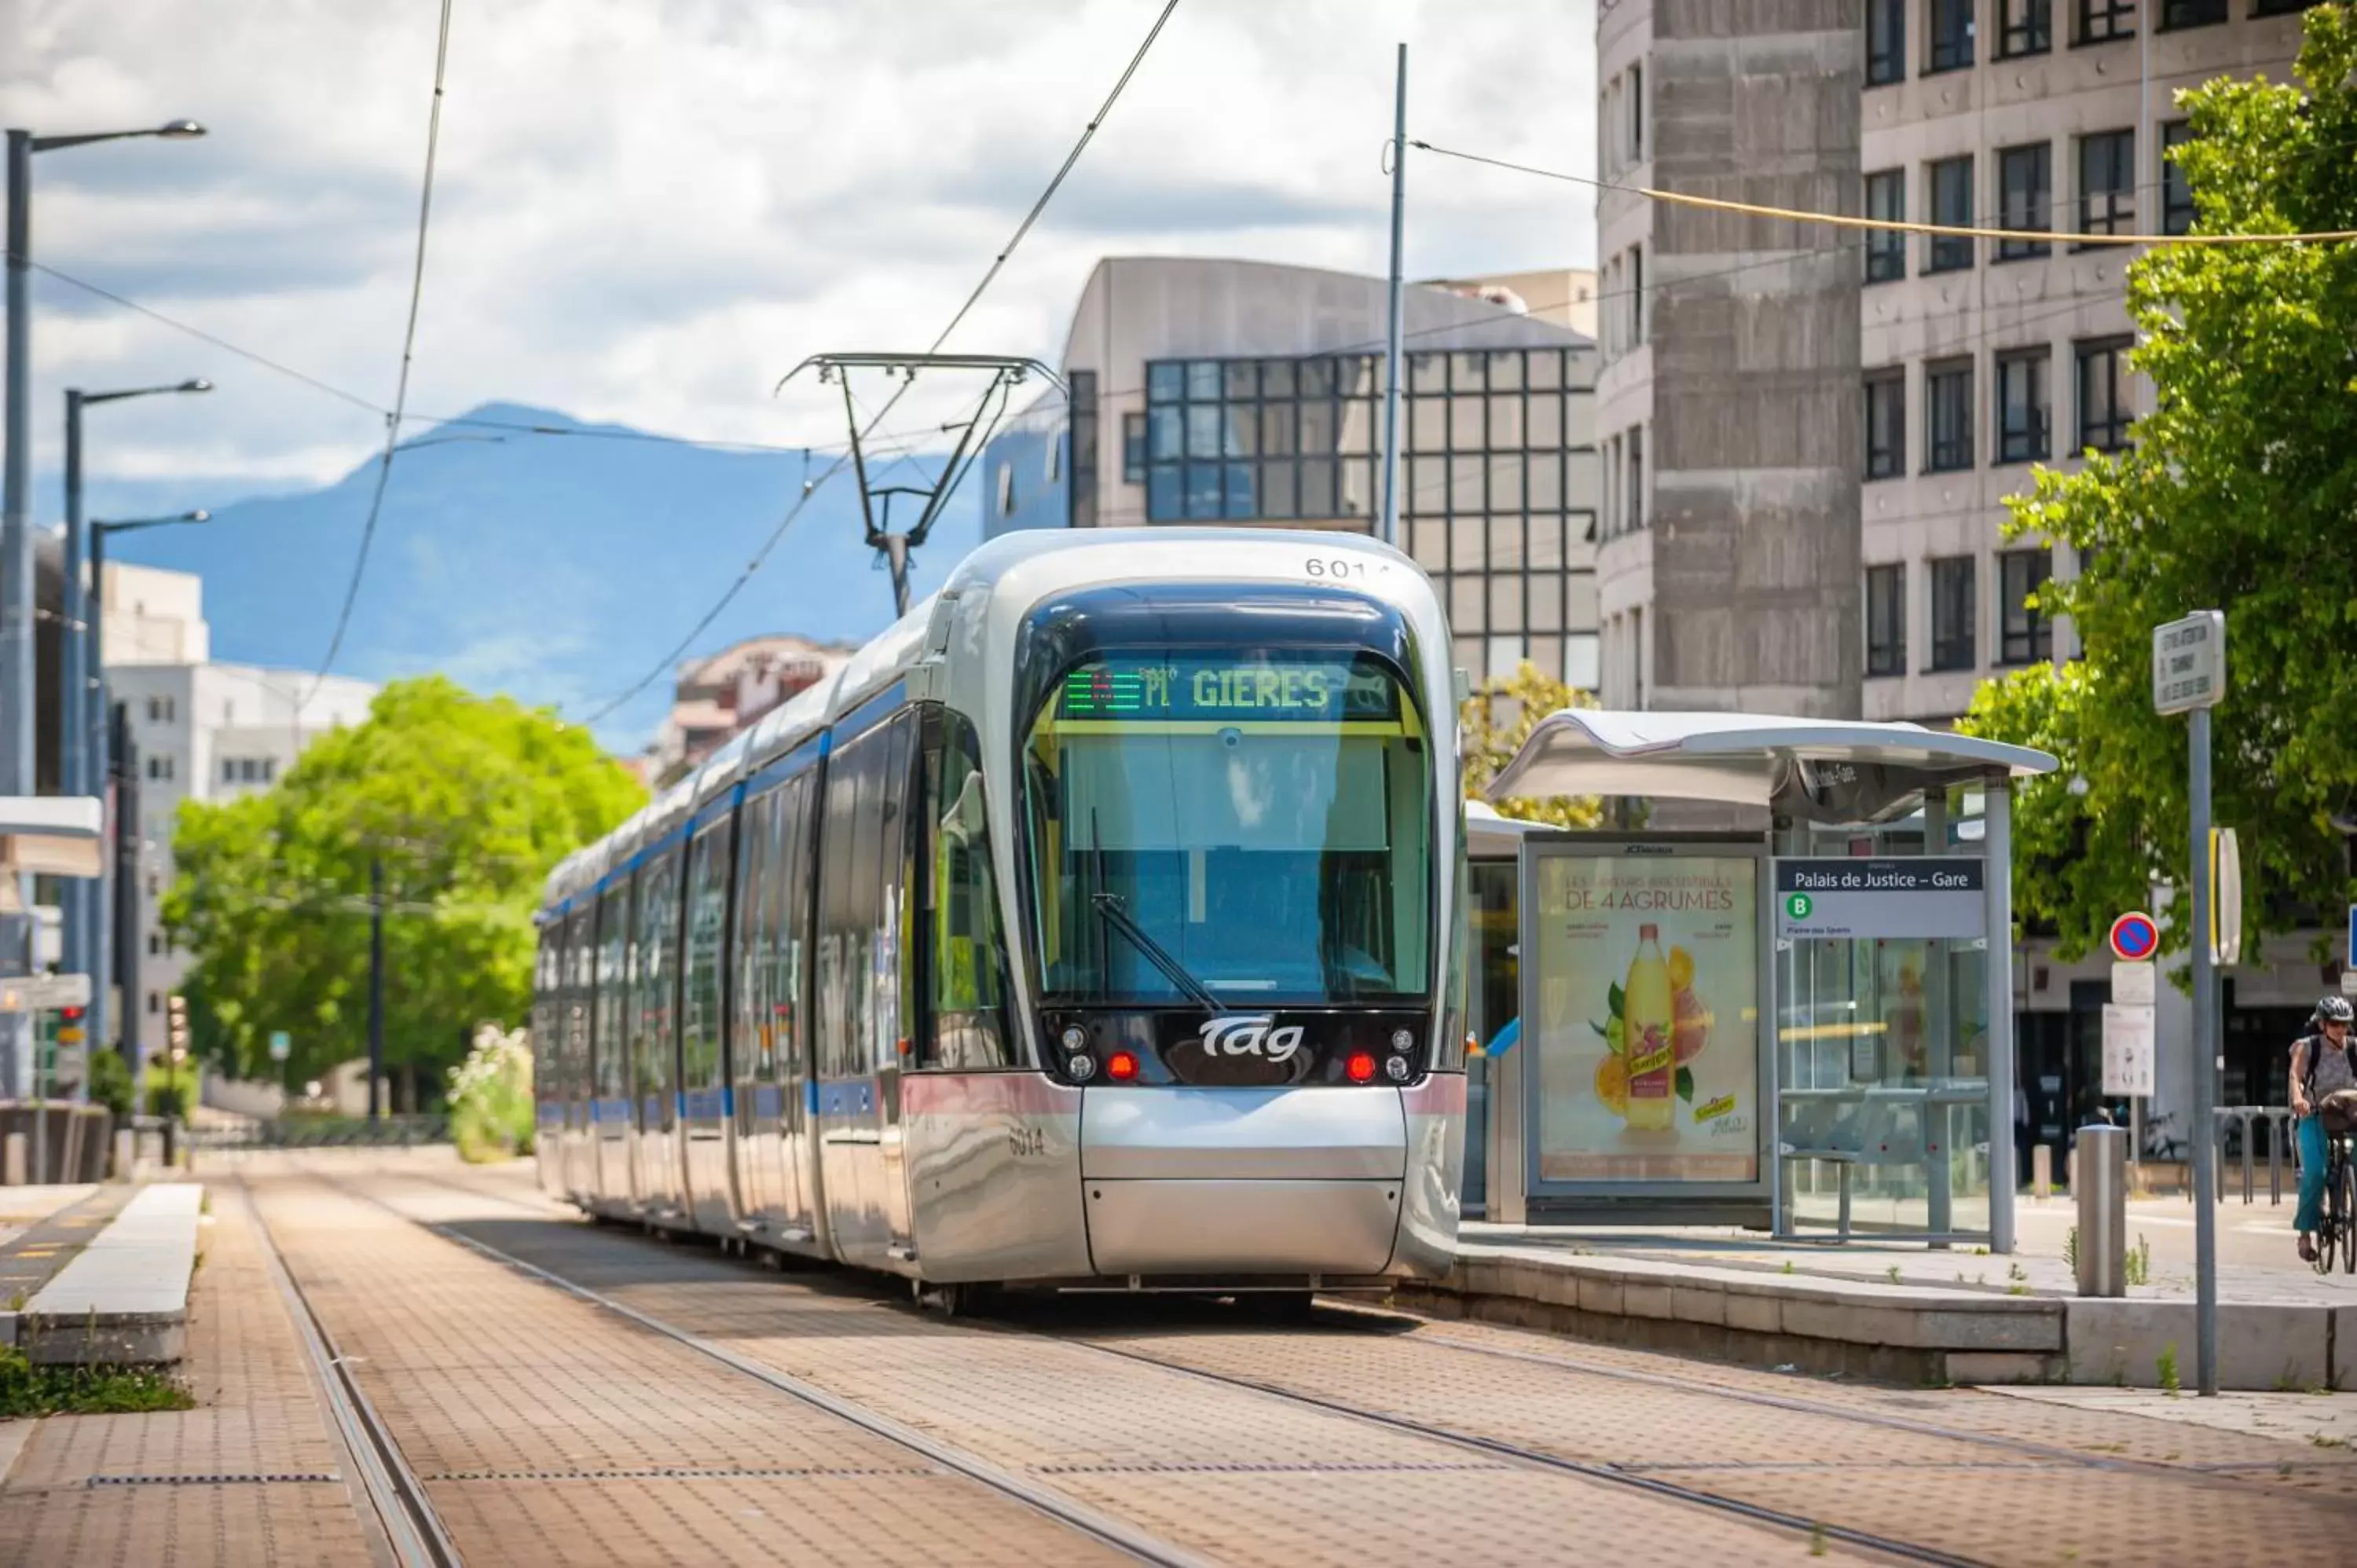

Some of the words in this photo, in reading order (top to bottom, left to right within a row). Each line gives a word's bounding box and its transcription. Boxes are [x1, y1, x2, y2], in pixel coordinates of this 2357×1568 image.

[1193, 669, 1329, 707] GIERES
[1795, 872, 1838, 888] Palais
[1842, 872, 1860, 888] de
[1864, 872, 1916, 888] Justice
[1932, 872, 1968, 887] Gare
[1566, 891, 1595, 910] DE
[1600, 892, 1615, 910] 4
[1620, 890, 1733, 910] AGRUMES
[1794, 898, 1806, 915] B
